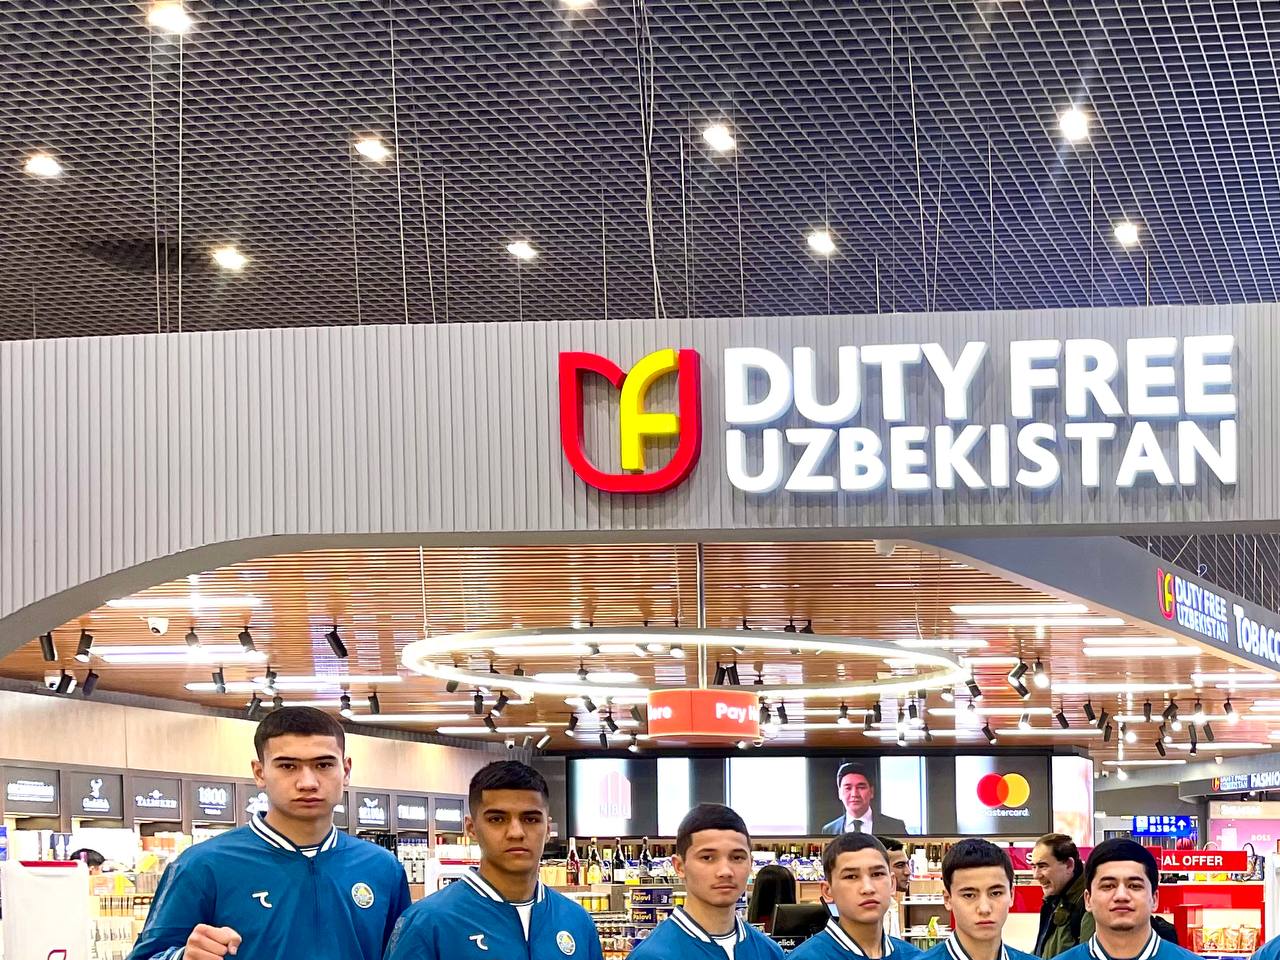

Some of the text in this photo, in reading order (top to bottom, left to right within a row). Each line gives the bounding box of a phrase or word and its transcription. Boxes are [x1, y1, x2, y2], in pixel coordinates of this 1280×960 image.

[723, 334, 1239, 425] DUTY FREE
[724, 419, 1239, 495] UZBEKISTAN
[1174, 575, 1228, 623] DUTY FREE
[1176, 602, 1229, 644] UZBEKISTAN
[648, 704, 673, 720] ere
[715, 702, 746, 724] Pay
[1149, 816, 1176, 824] B1 B2
[1149, 824, 1177, 833] B3 B4
[1182, 855, 1223, 867] OFFER
[777, 938, 796, 947] click
